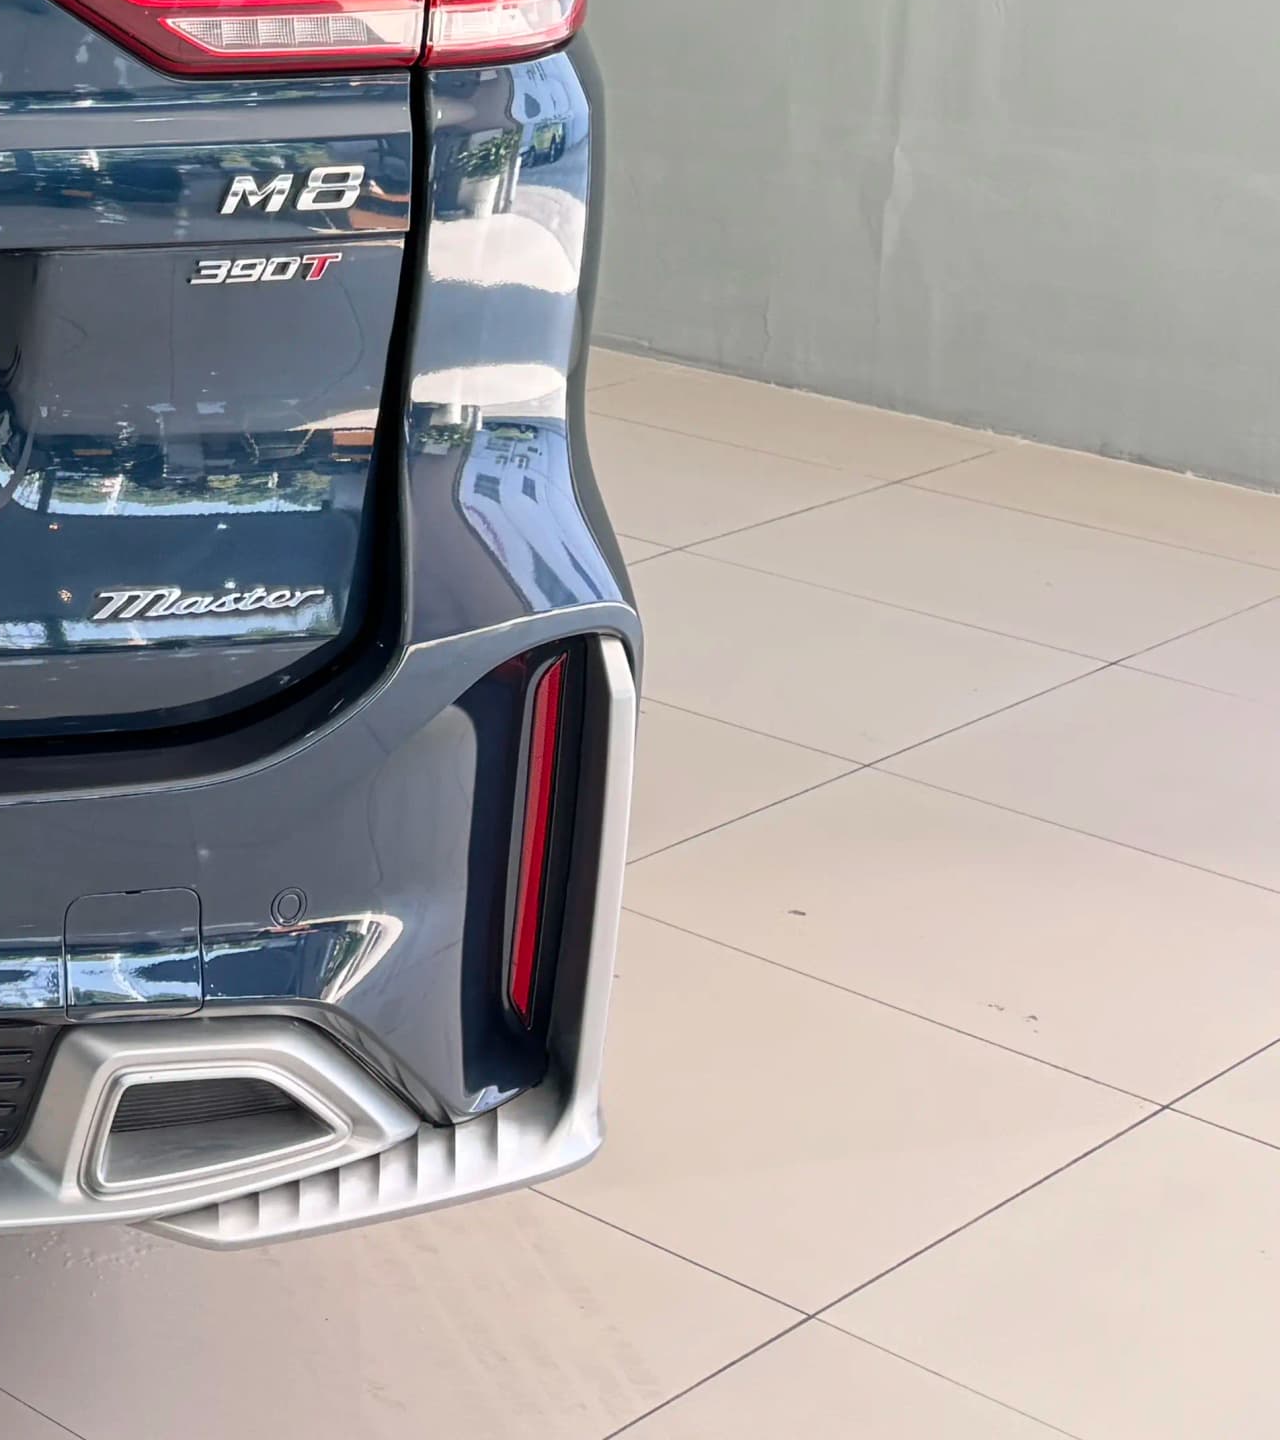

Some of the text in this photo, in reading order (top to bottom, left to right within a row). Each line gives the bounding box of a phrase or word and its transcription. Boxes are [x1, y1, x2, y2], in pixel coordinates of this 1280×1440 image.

[219, 164, 366, 215] M8
[188, 251, 343, 285] 390T
[93, 586, 326, 620] Master
